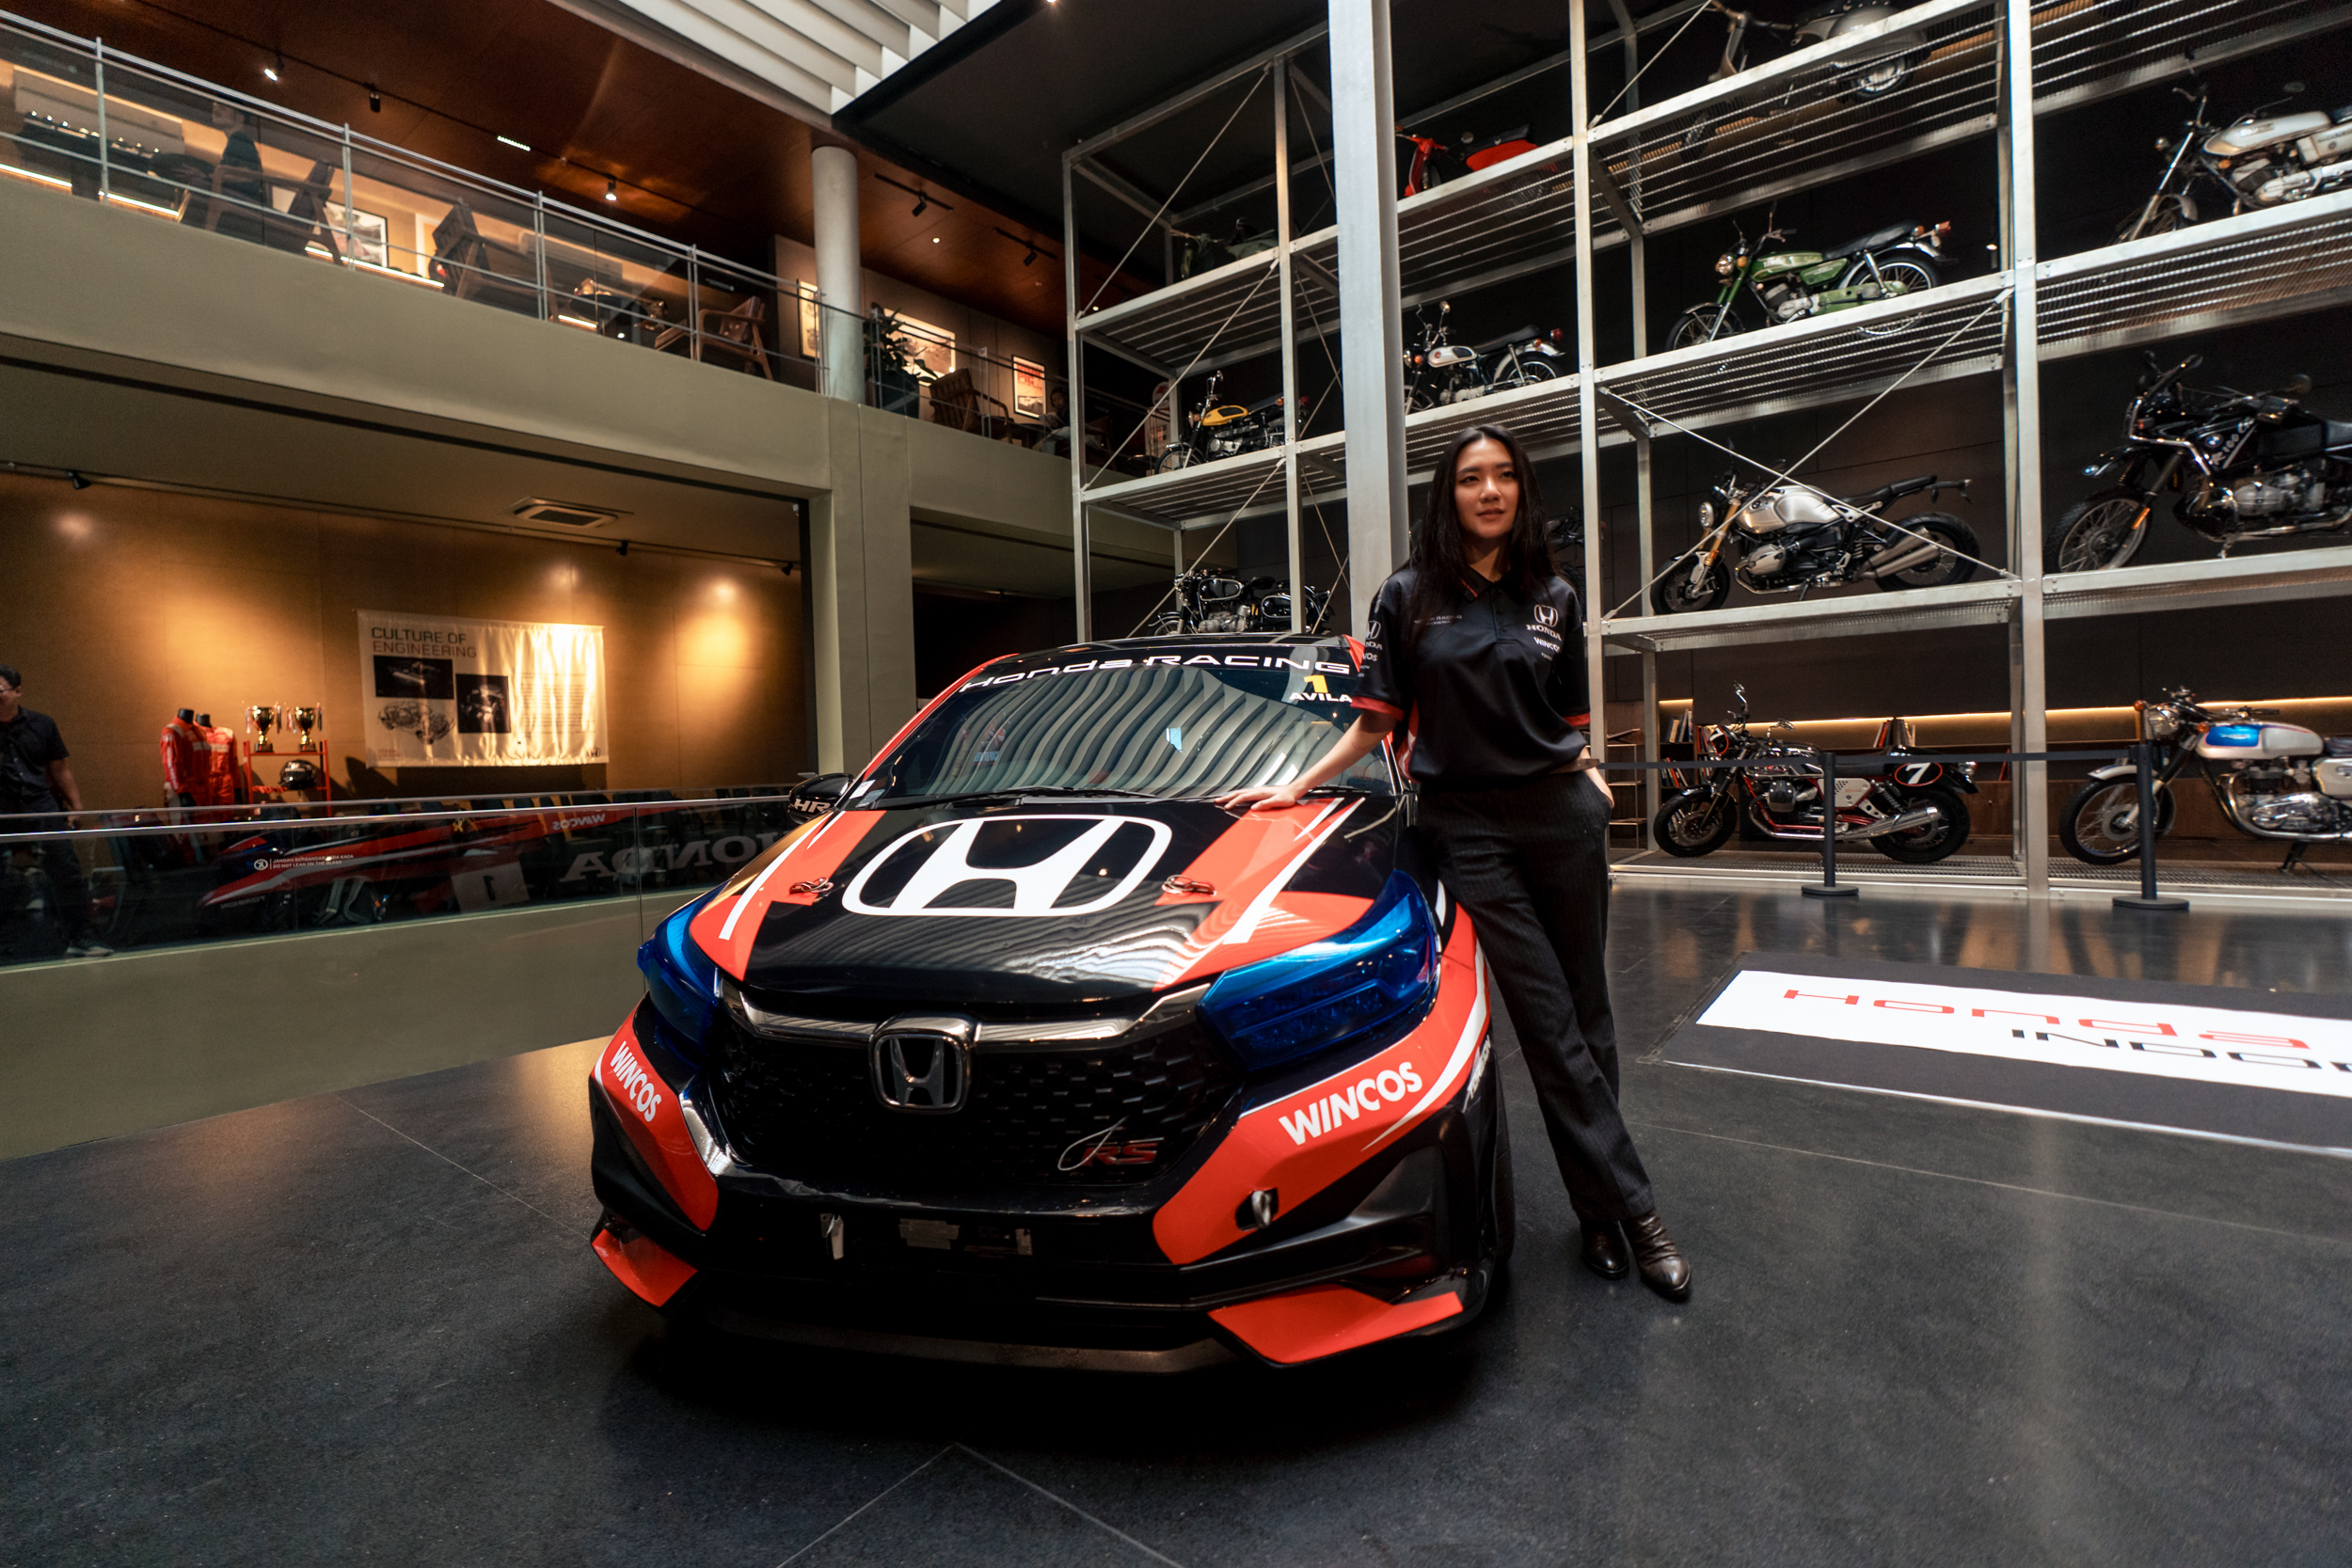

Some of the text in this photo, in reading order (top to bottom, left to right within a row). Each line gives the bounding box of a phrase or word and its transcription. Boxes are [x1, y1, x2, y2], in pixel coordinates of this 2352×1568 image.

[372, 626, 467, 644] CULTURE OF
[1526, 624, 1562, 641] HONDA
[373, 641, 477, 658] ENGINEERING
[959, 654, 1350, 693] Honda RACING
[1303, 674, 1328, 693] 1
[1289, 691, 1353, 704] AVILA
[1905, 762, 1931, 784] 7
[1783, 989, 2311, 1050] Honda
[2011, 1028, 2352, 1072] INDO
[610, 1040, 661, 1122] WINCOS
[1278, 1061, 1423, 1146] WINCOS
[1081, 1141, 1161, 1166] RS
